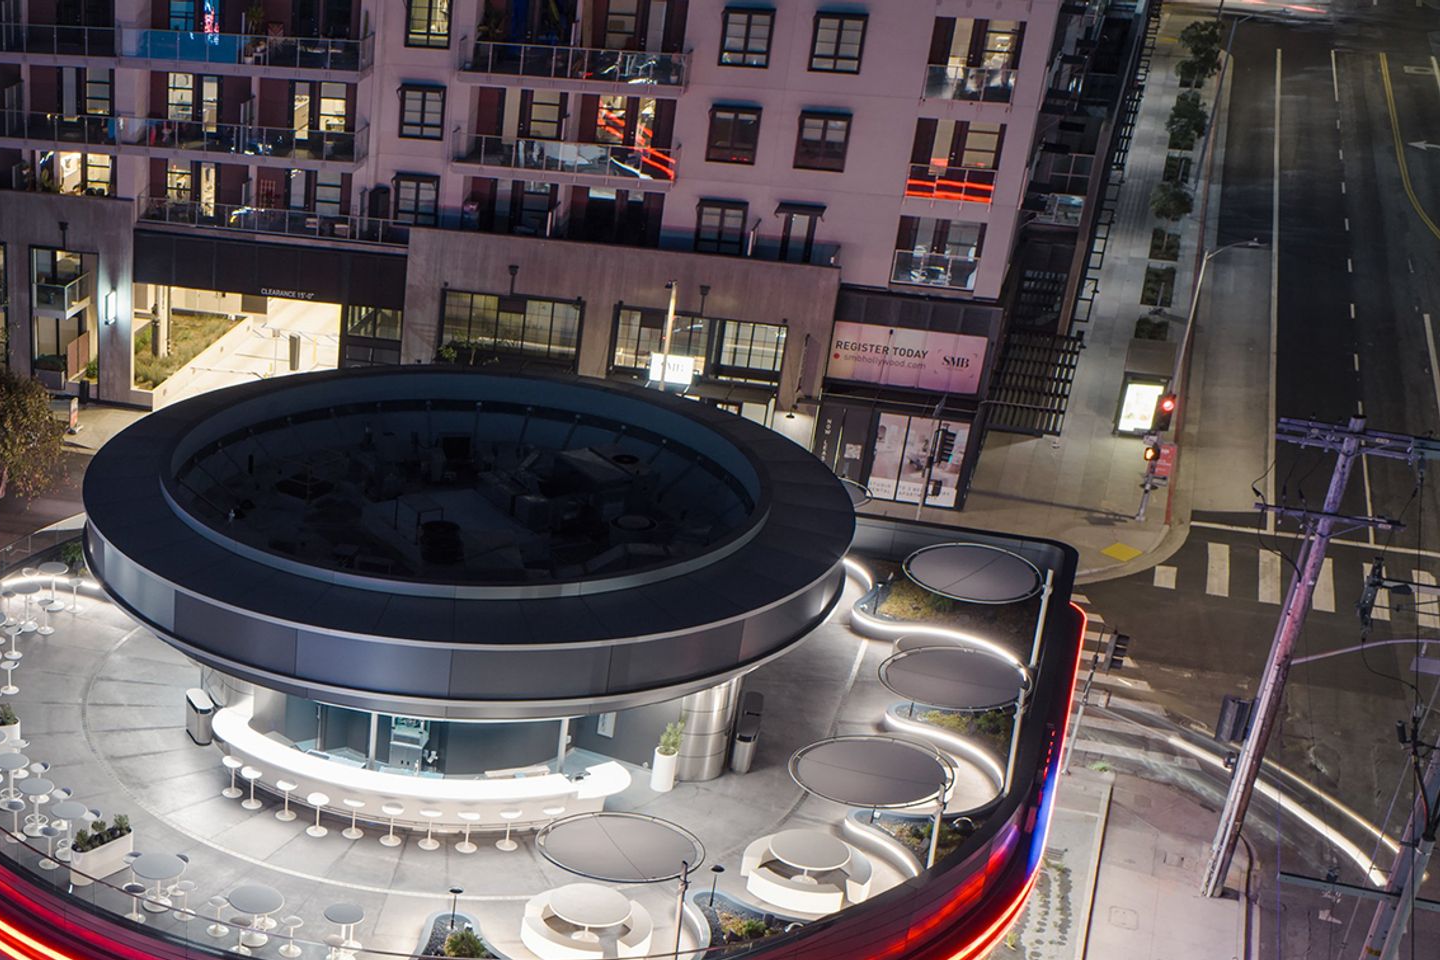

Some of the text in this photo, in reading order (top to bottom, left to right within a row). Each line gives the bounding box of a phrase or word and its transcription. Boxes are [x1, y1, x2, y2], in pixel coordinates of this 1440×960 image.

[261, 288, 296, 298] CLEARANCE
[835, 340, 929, 359] REGISTER TODAY
[843, 353, 926, 370] smbhollywood.com
[942, 355, 970, 369] SMB
